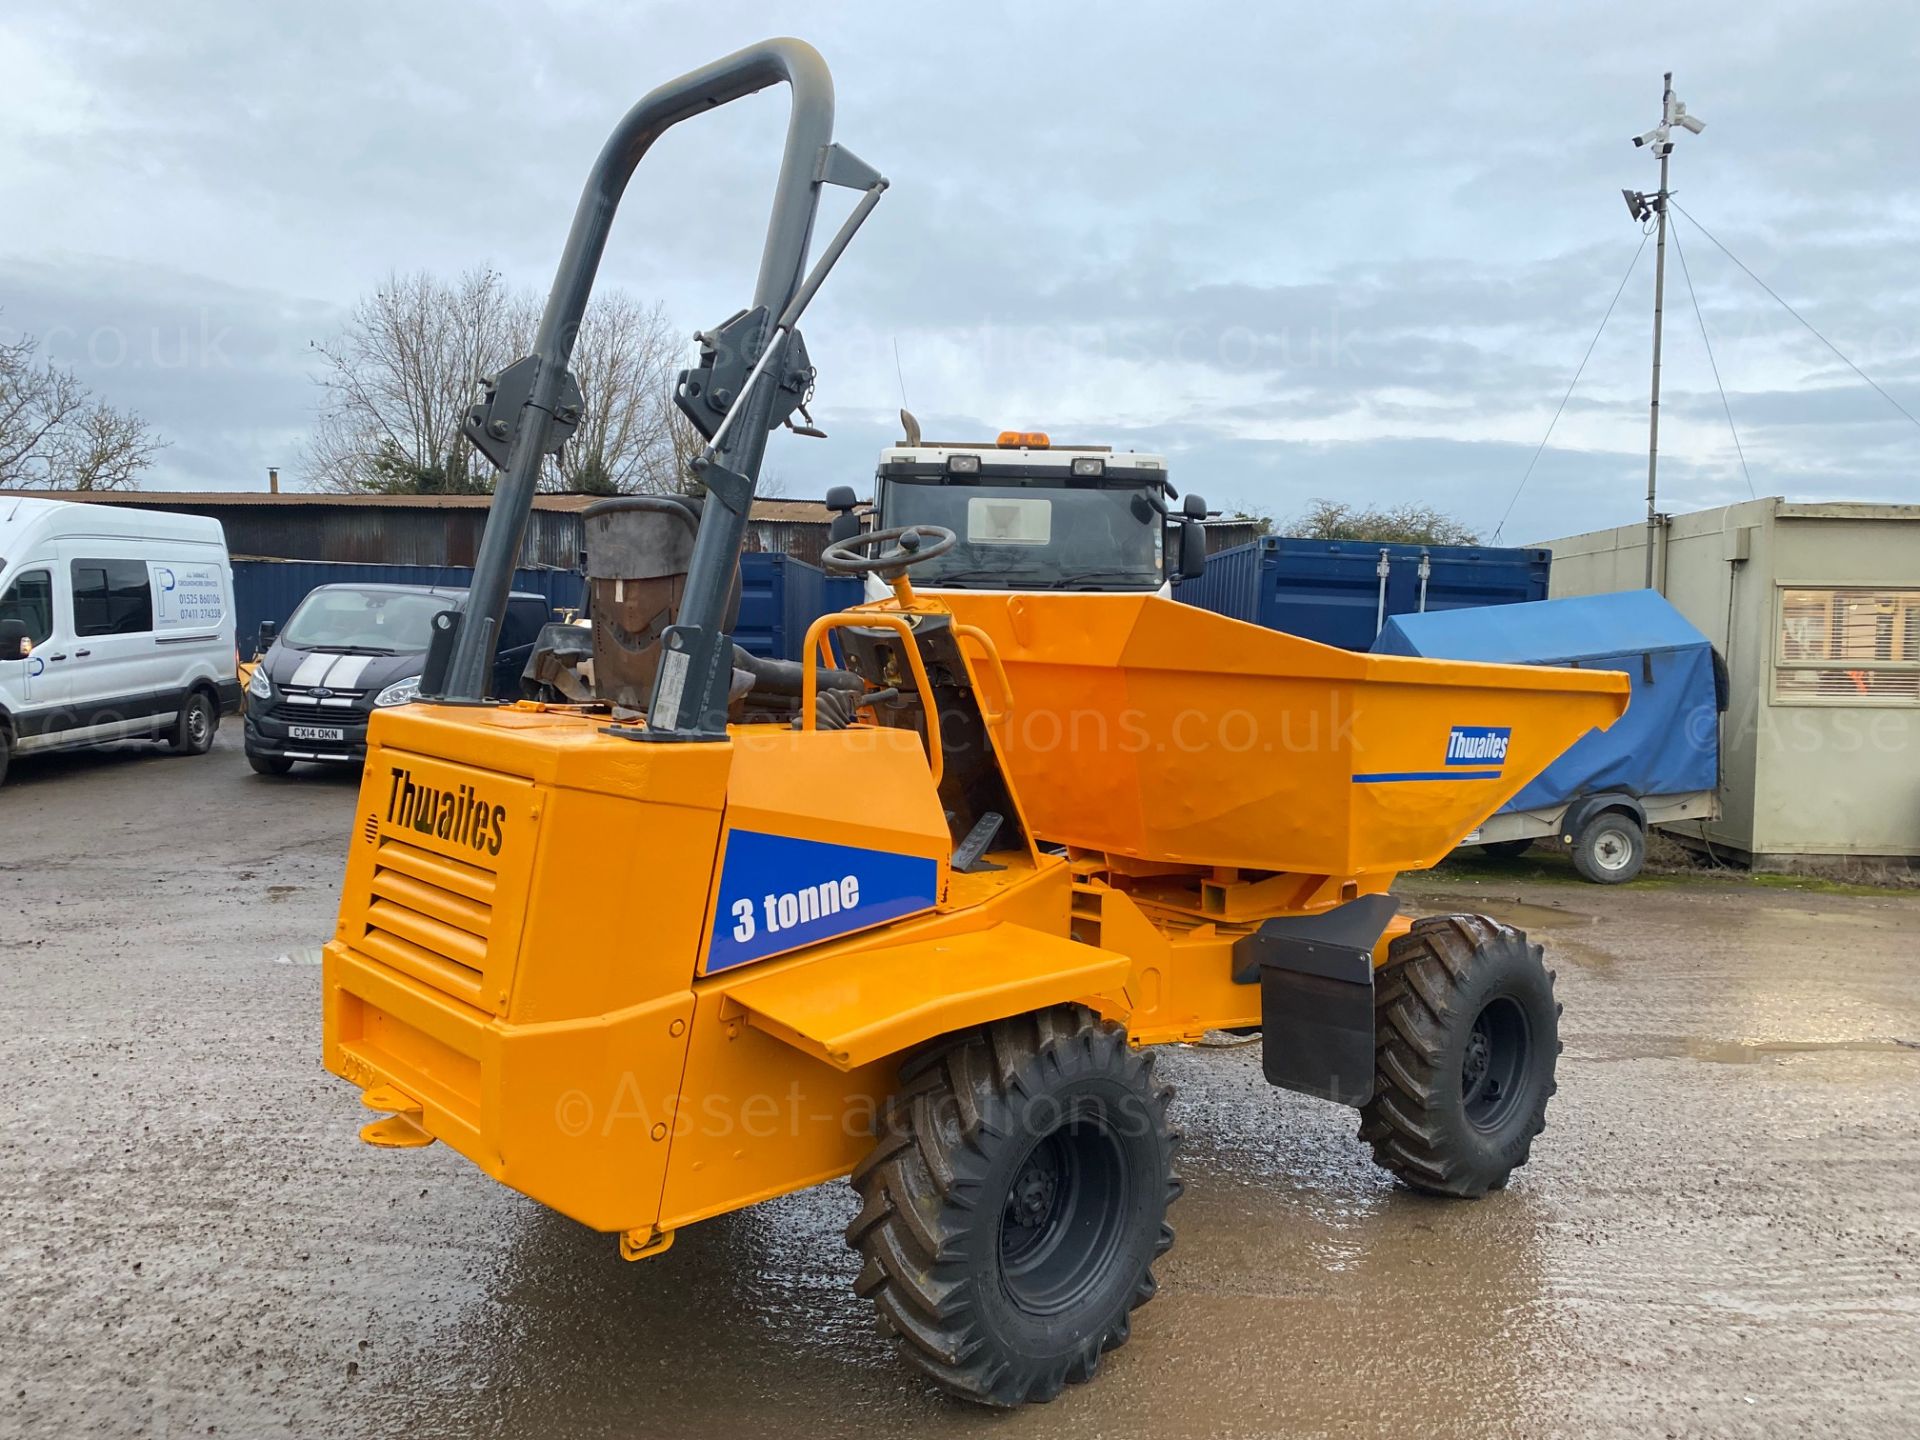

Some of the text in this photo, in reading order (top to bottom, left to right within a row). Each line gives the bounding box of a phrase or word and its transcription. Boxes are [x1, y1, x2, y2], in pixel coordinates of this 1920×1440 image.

[179, 593, 198, 604] 01525
[181, 609, 198, 619] 07411
[294, 727, 338, 739] CX14 OKN
[1448, 731, 1509, 759] Thwaites
[387, 767, 506, 856] Thwaites
[731, 875, 860, 943] 3 tonne
